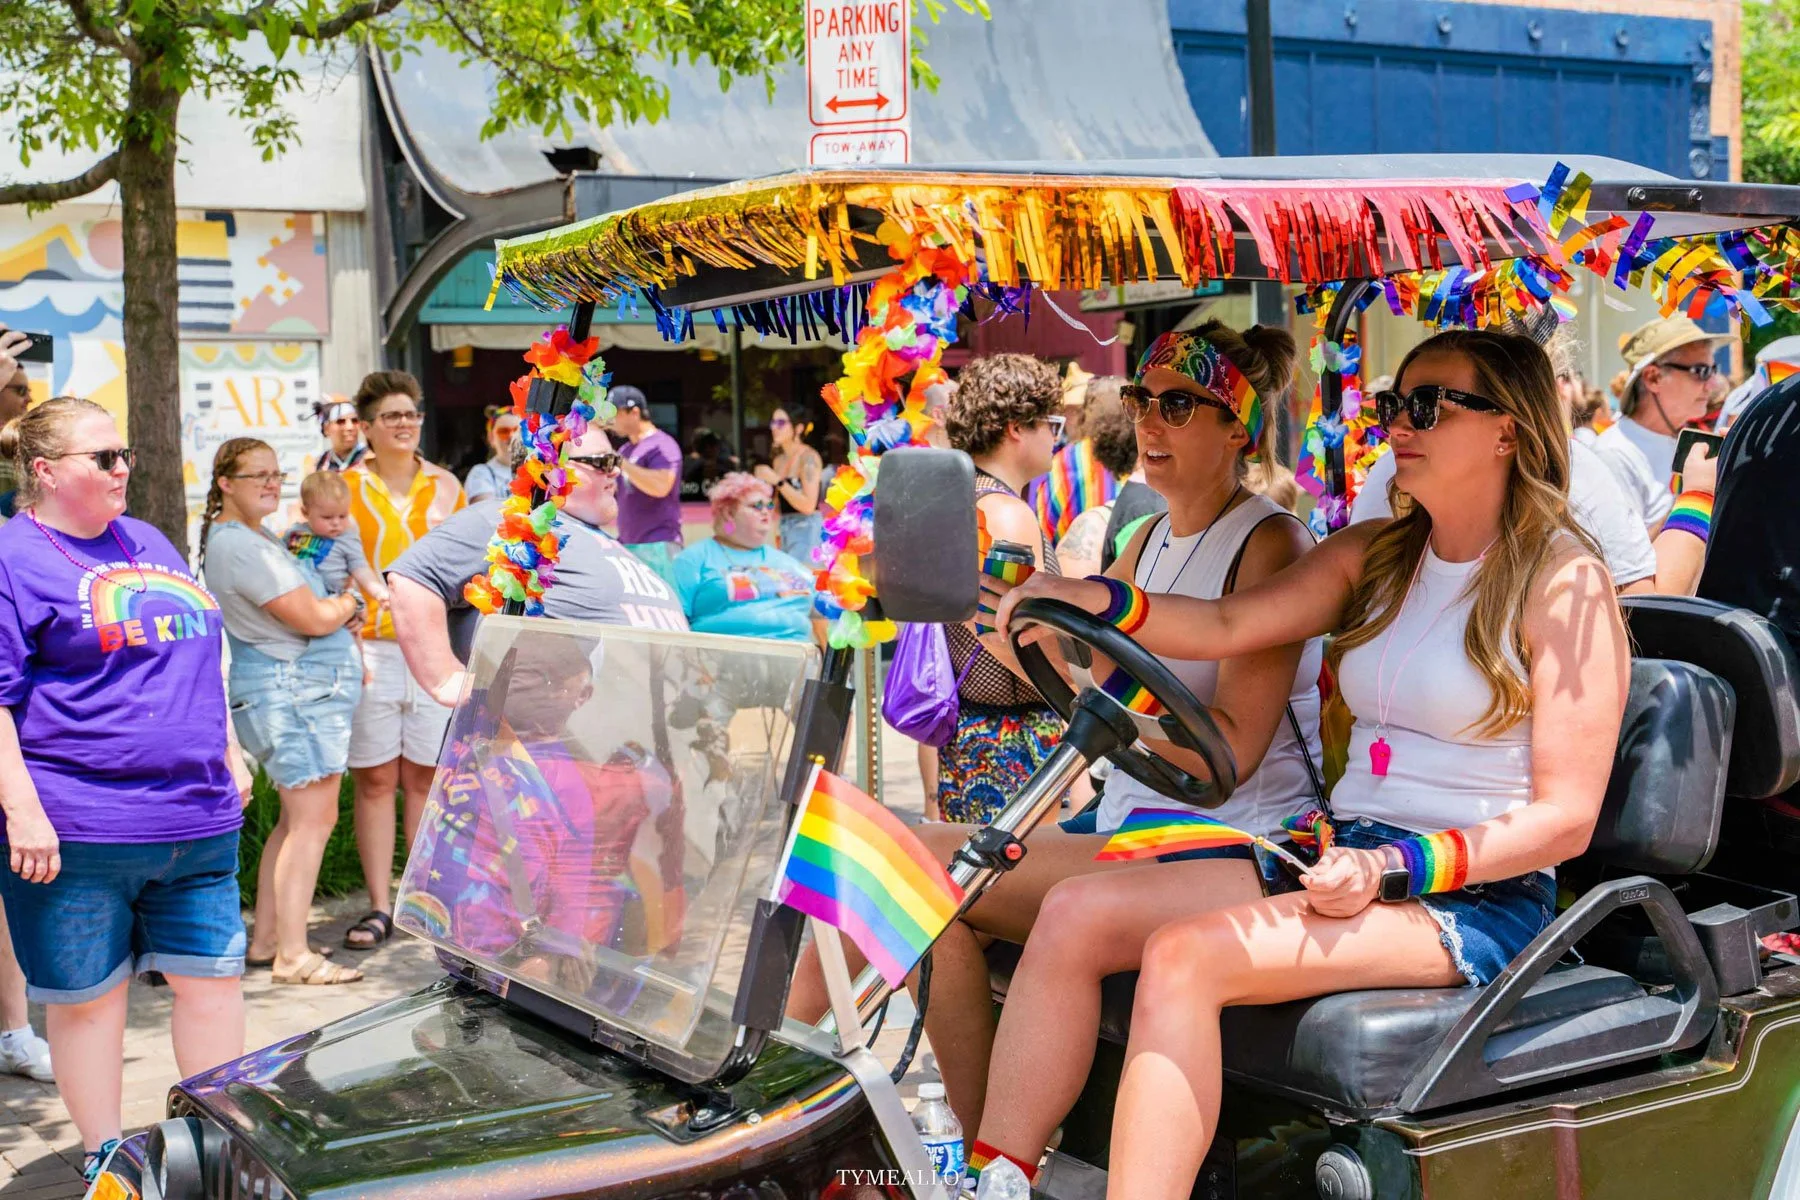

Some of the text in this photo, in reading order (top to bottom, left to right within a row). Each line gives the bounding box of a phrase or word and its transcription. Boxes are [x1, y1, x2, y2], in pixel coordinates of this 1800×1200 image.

[813, 2, 899, 38] PARKING
[838, 40, 875, 63] ANY
[836, 66, 879, 89] TIME
[155, 563, 169, 573] BE
[79, 602, 91, 611] A
[81, 613, 93, 629] IN
[98, 619, 148, 653] BE
